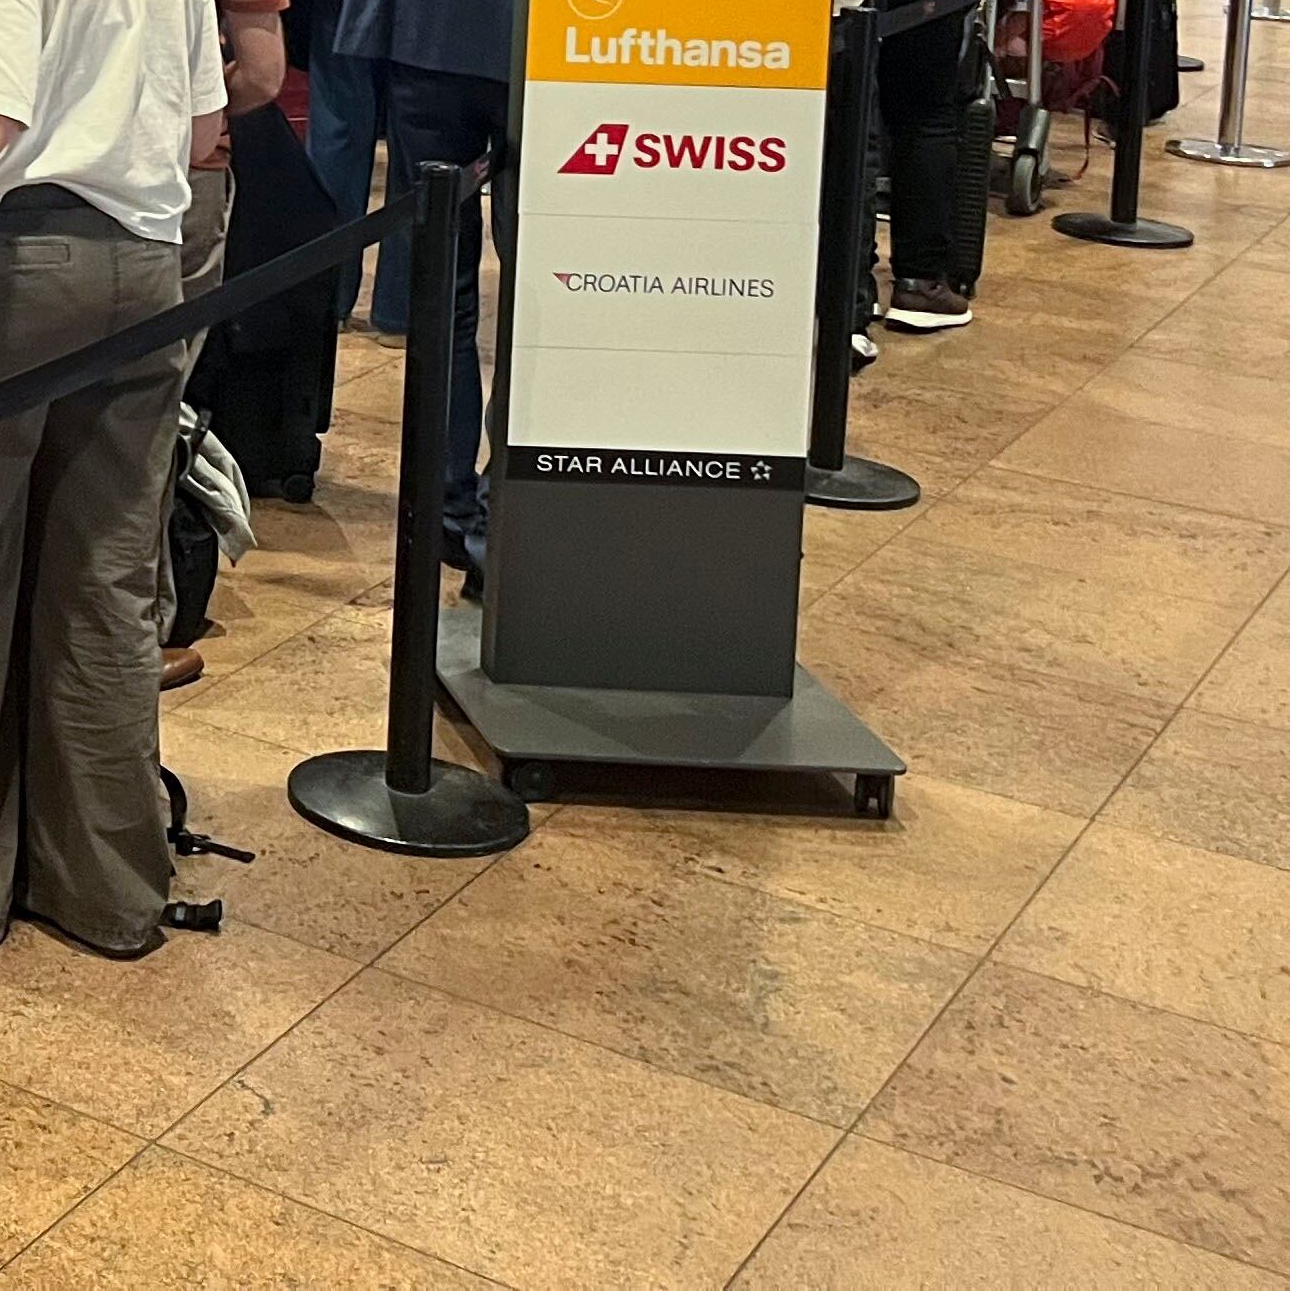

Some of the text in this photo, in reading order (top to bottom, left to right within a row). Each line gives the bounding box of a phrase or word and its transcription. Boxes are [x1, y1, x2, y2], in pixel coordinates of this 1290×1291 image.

[565, 26, 791, 70] Lufthansa
[633, 133, 787, 173] SWISS
[566, 272, 775, 298] CROATIA AIRLINES
[536, 454, 741, 480] STAR ALLIANCE
